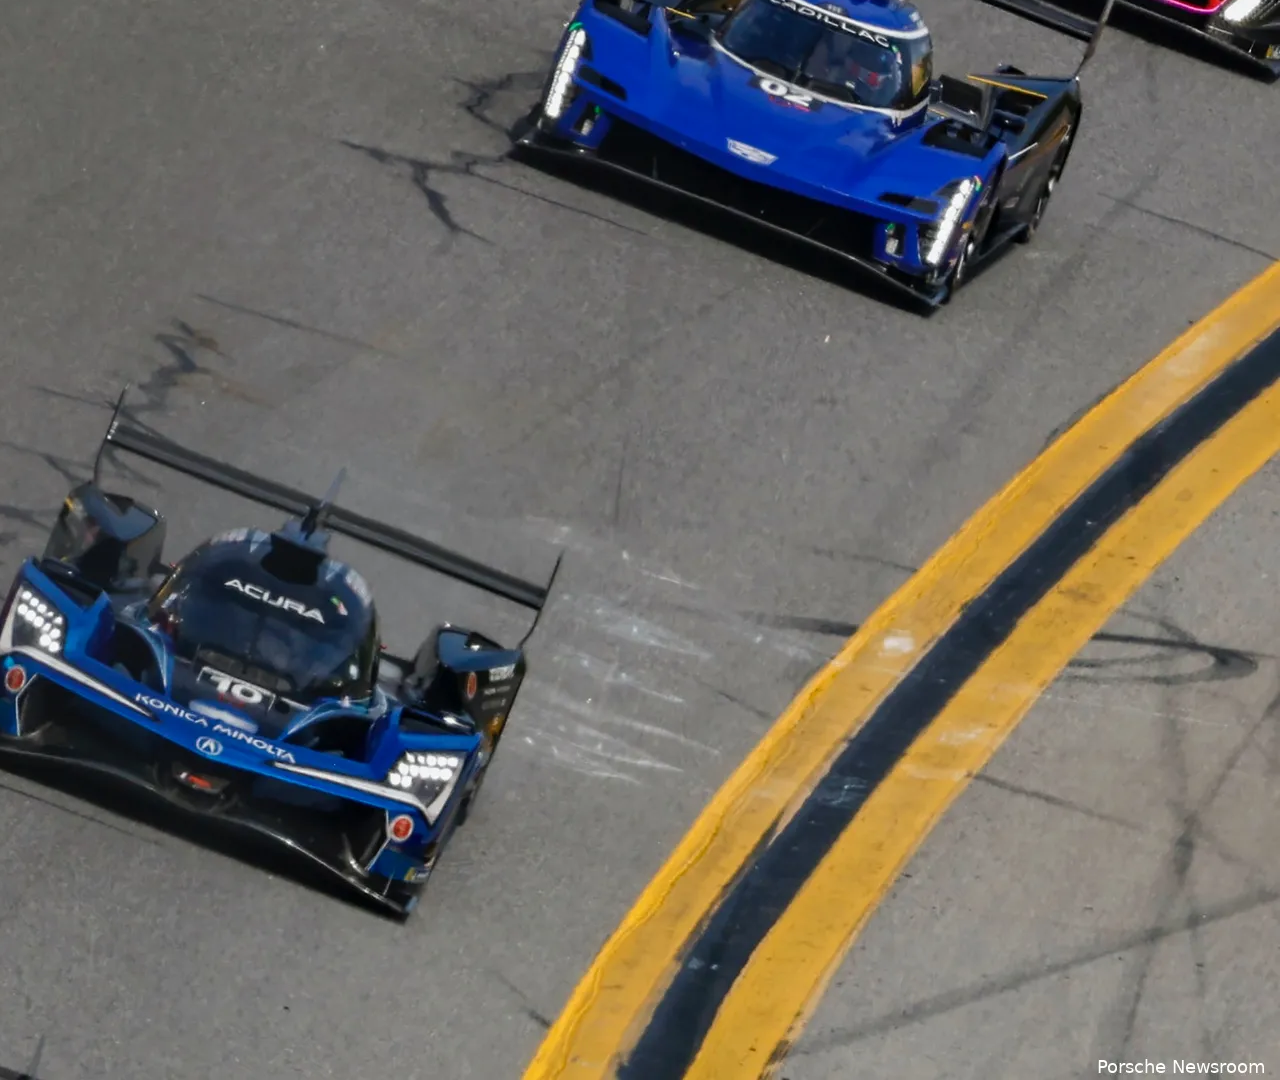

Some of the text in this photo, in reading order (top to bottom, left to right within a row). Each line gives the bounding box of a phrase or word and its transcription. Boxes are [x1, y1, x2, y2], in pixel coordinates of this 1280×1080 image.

[760, 78, 813, 107] 02
[224, 579, 325, 625] ACURA
[210, 674, 263, 705] 10
[135, 693, 297, 764] KONICA MINOLTA
